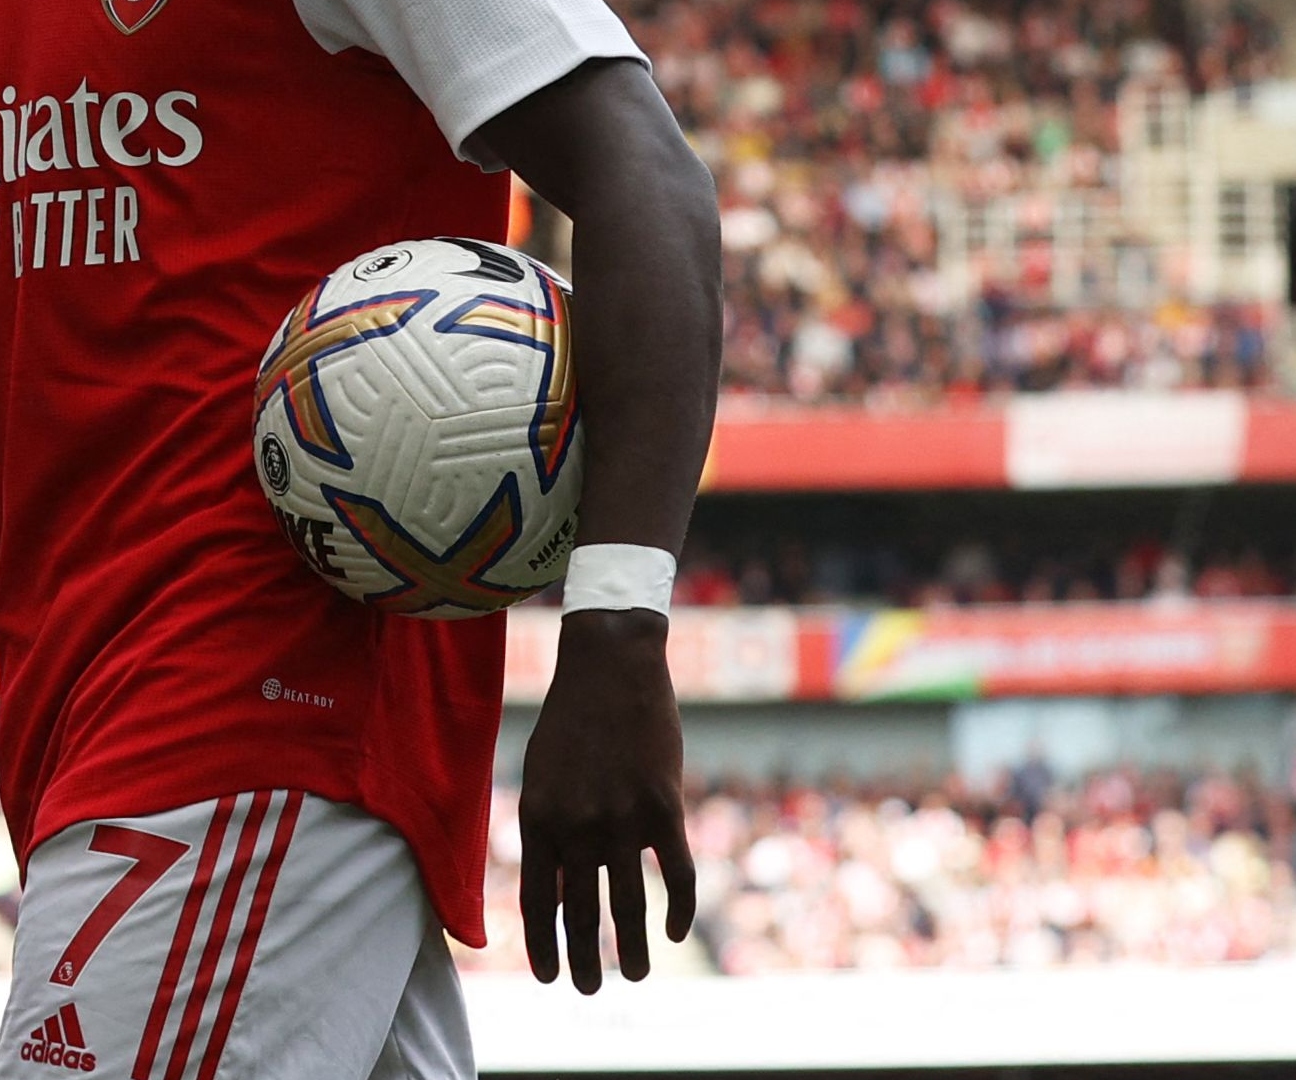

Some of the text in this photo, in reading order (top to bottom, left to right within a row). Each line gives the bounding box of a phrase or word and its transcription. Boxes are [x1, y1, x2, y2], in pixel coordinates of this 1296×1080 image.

[528, 517, 573, 572] NIKE
[283, 688, 335, 709] HEAT.RDY
[48, 823, 191, 987] 7
[20, 1039, 96, 1072] adidas
